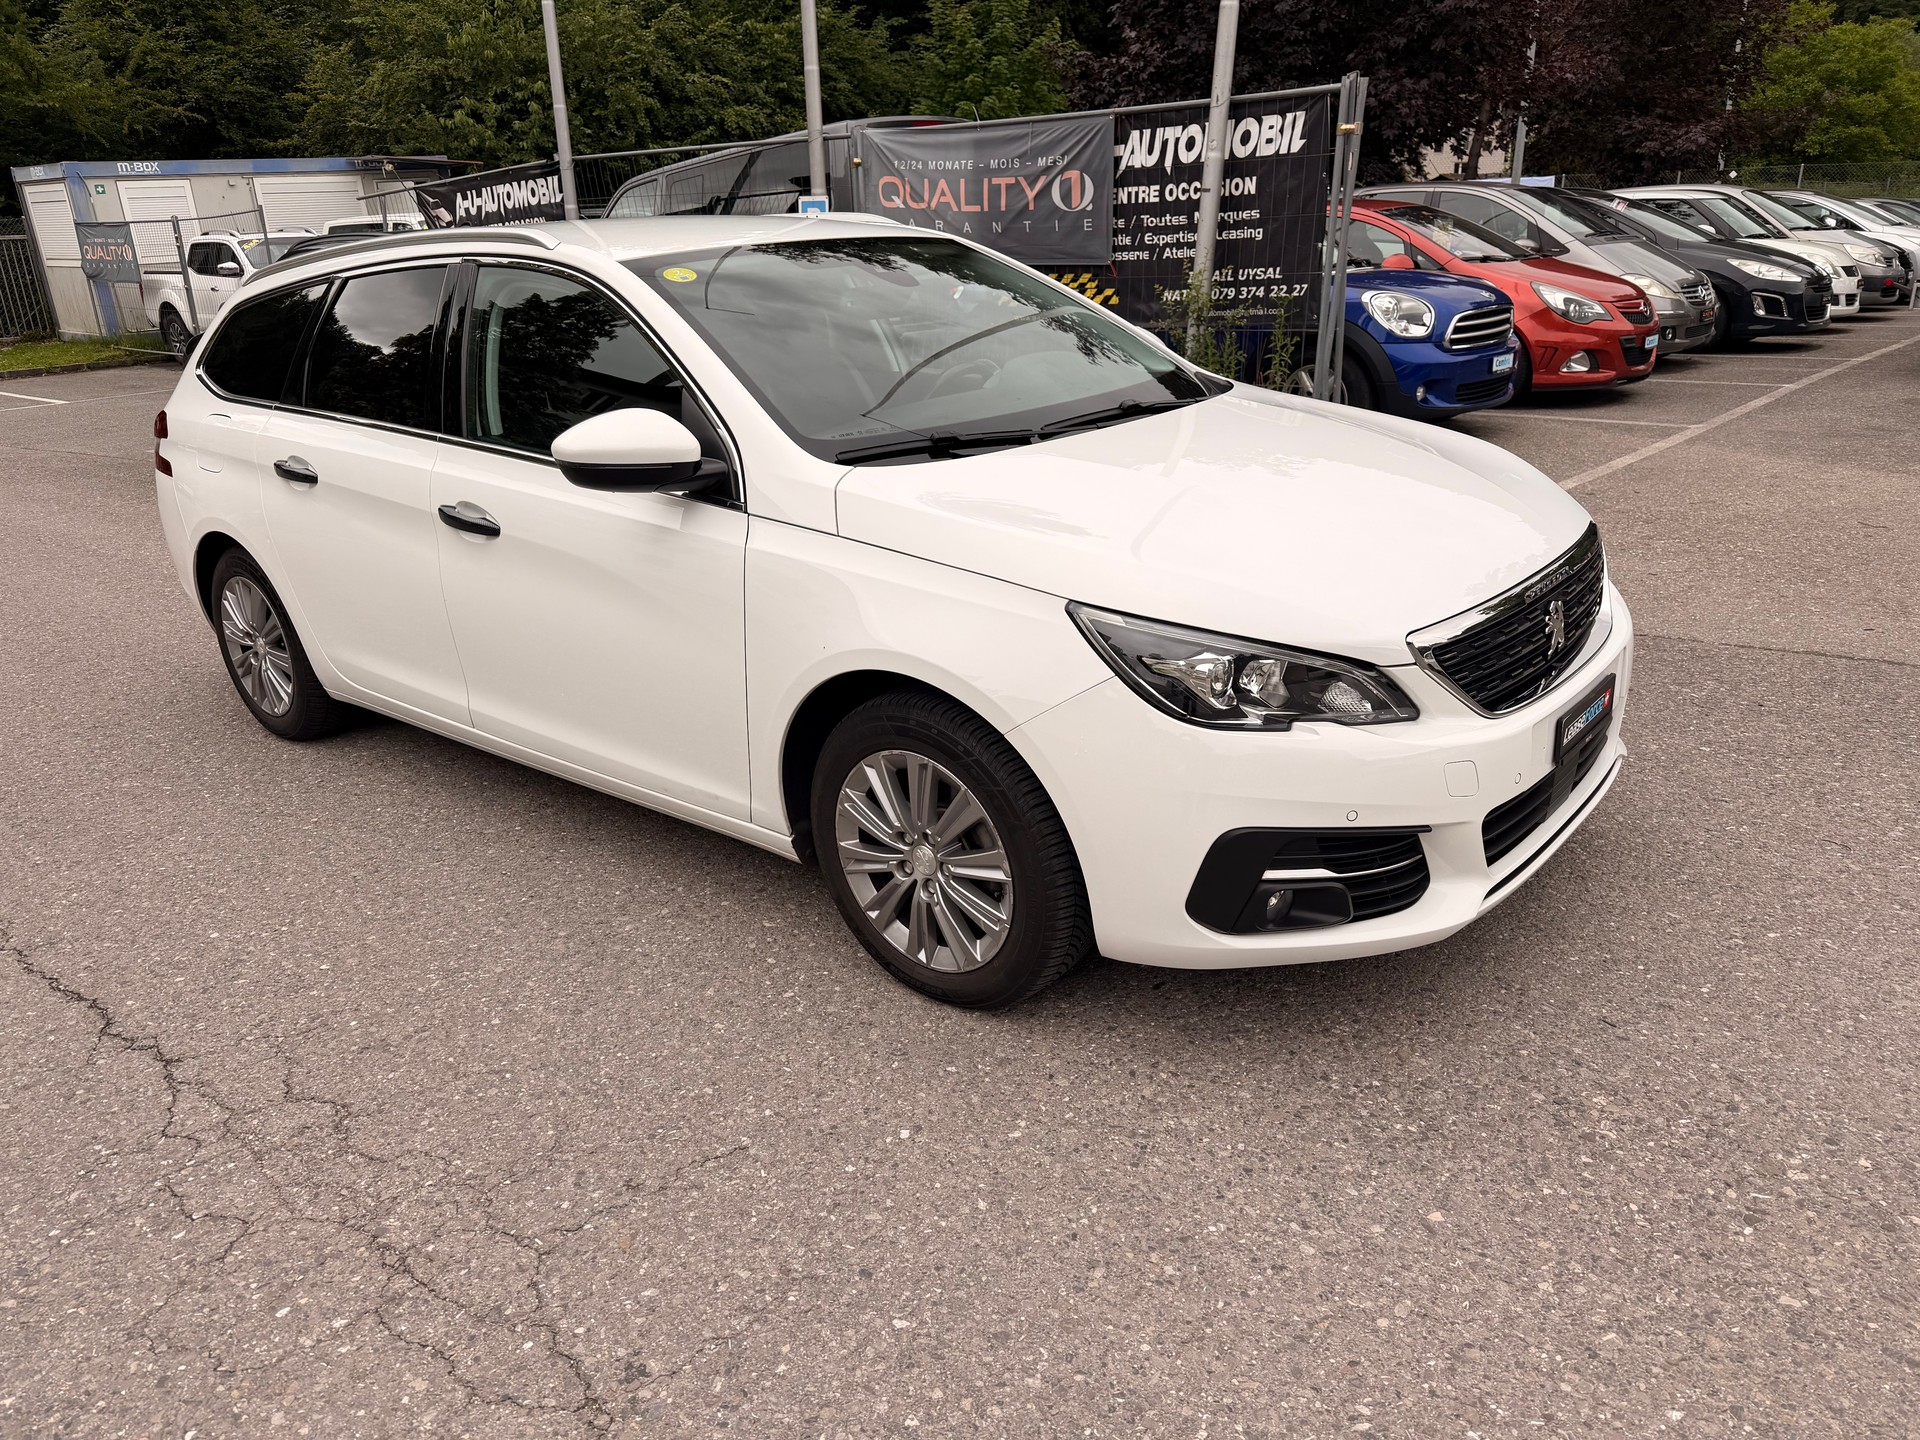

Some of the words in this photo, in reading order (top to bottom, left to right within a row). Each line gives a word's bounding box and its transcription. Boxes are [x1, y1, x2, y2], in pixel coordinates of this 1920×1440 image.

[893, 160, 923, 170] 12/24
[928, 160, 974, 170] MONATE
[990, 158, 1020, 169] MOIS
[878, 175, 1047, 212] QUALITY
[1113, 185, 1160, 204] NTRE
[1165, 176, 1257, 201] OCCION
[456, 175, 564, 223] A-U-AUTOMOBIL
[908, 218, 1093, 234] ARANTIE
[1140, 214, 1188, 227] Toutes
[1194, 209, 1260, 224] Mrques
[83, 245, 122, 260] QUALITY
[1163, 246, 1196, 259] Atelie
[1238, 266, 1283, 280] UYSAL
[1211, 287, 1235, 300] 079
[1238, 286, 1265, 299] 374
[1269, 285, 1288, 297] 22
[1291, 284, 1308, 296] 27
